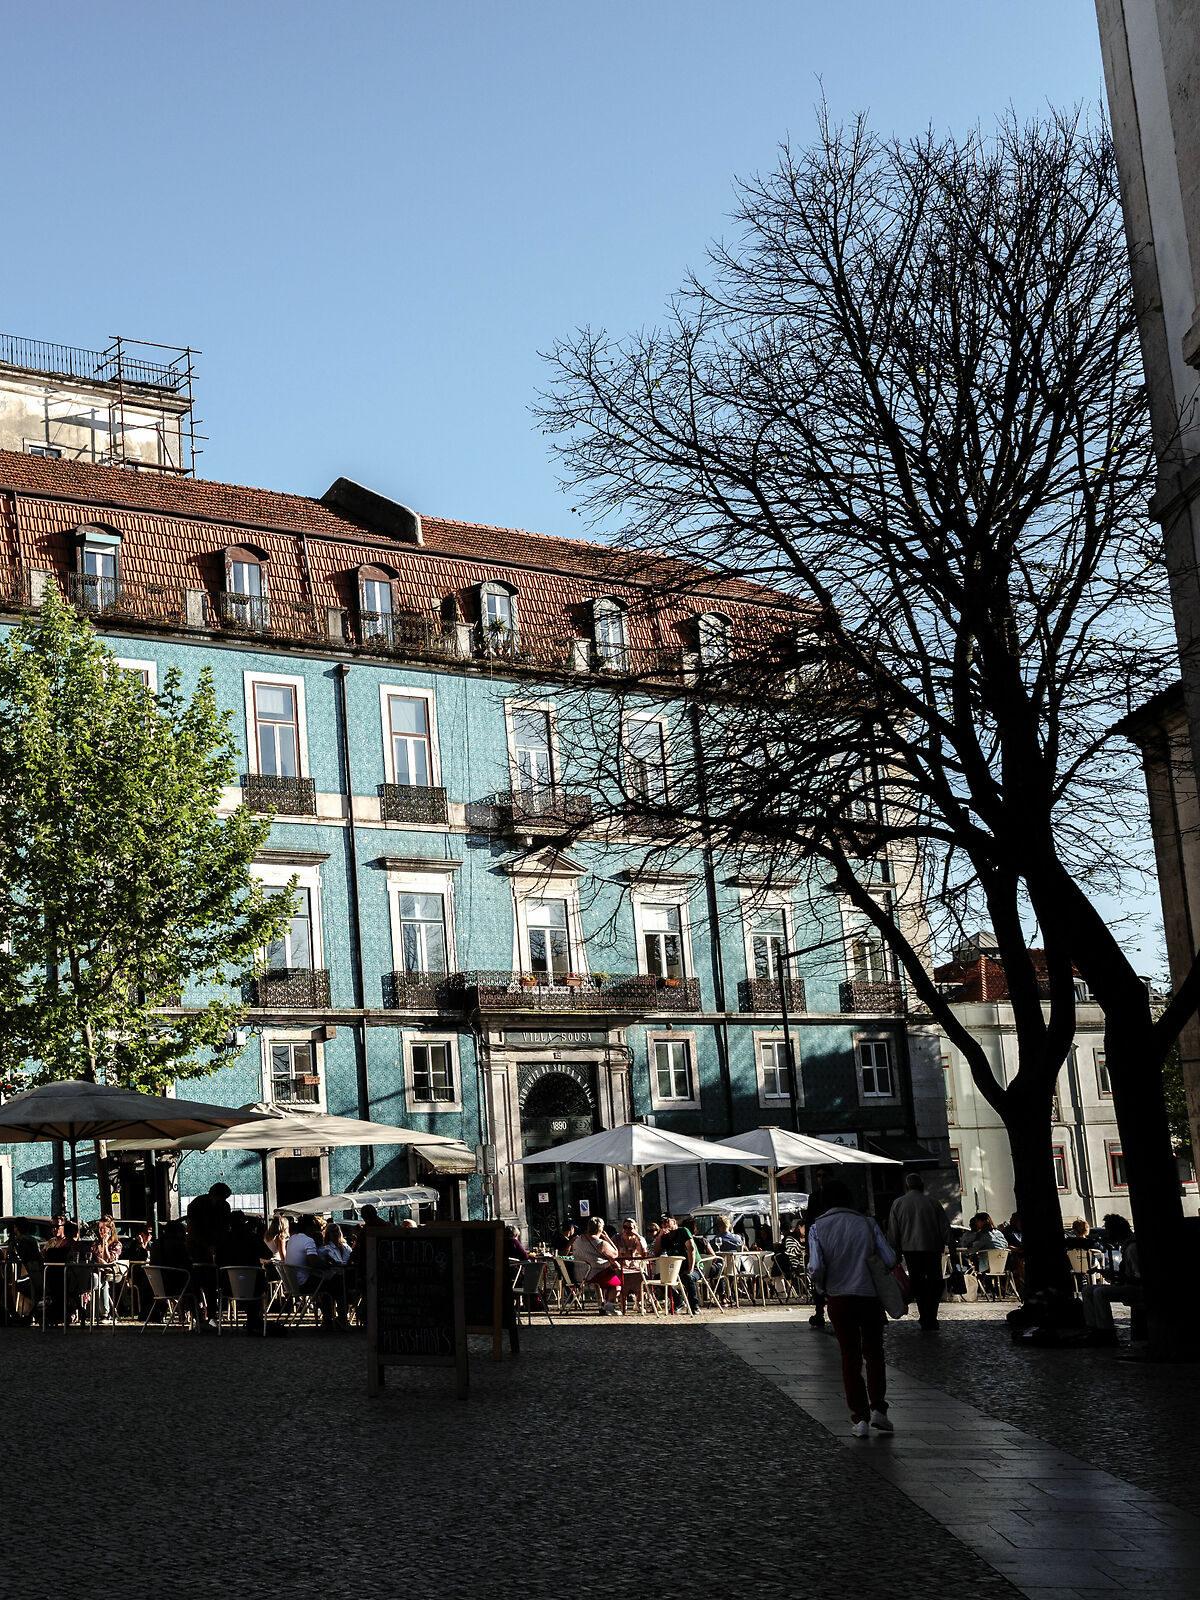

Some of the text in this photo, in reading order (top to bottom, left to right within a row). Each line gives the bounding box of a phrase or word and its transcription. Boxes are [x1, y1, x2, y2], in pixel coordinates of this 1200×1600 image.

[522, 1032, 592, 1042] VILLA SOUSA
[541, 1064, 550, 1074] DE
[553, 1064, 575, 1077] SOUSA
[582, 1083, 596, 1109] FILHO
[552, 1121, 567, 1131] 1890
[378, 1240, 434, 1264] GELATO
